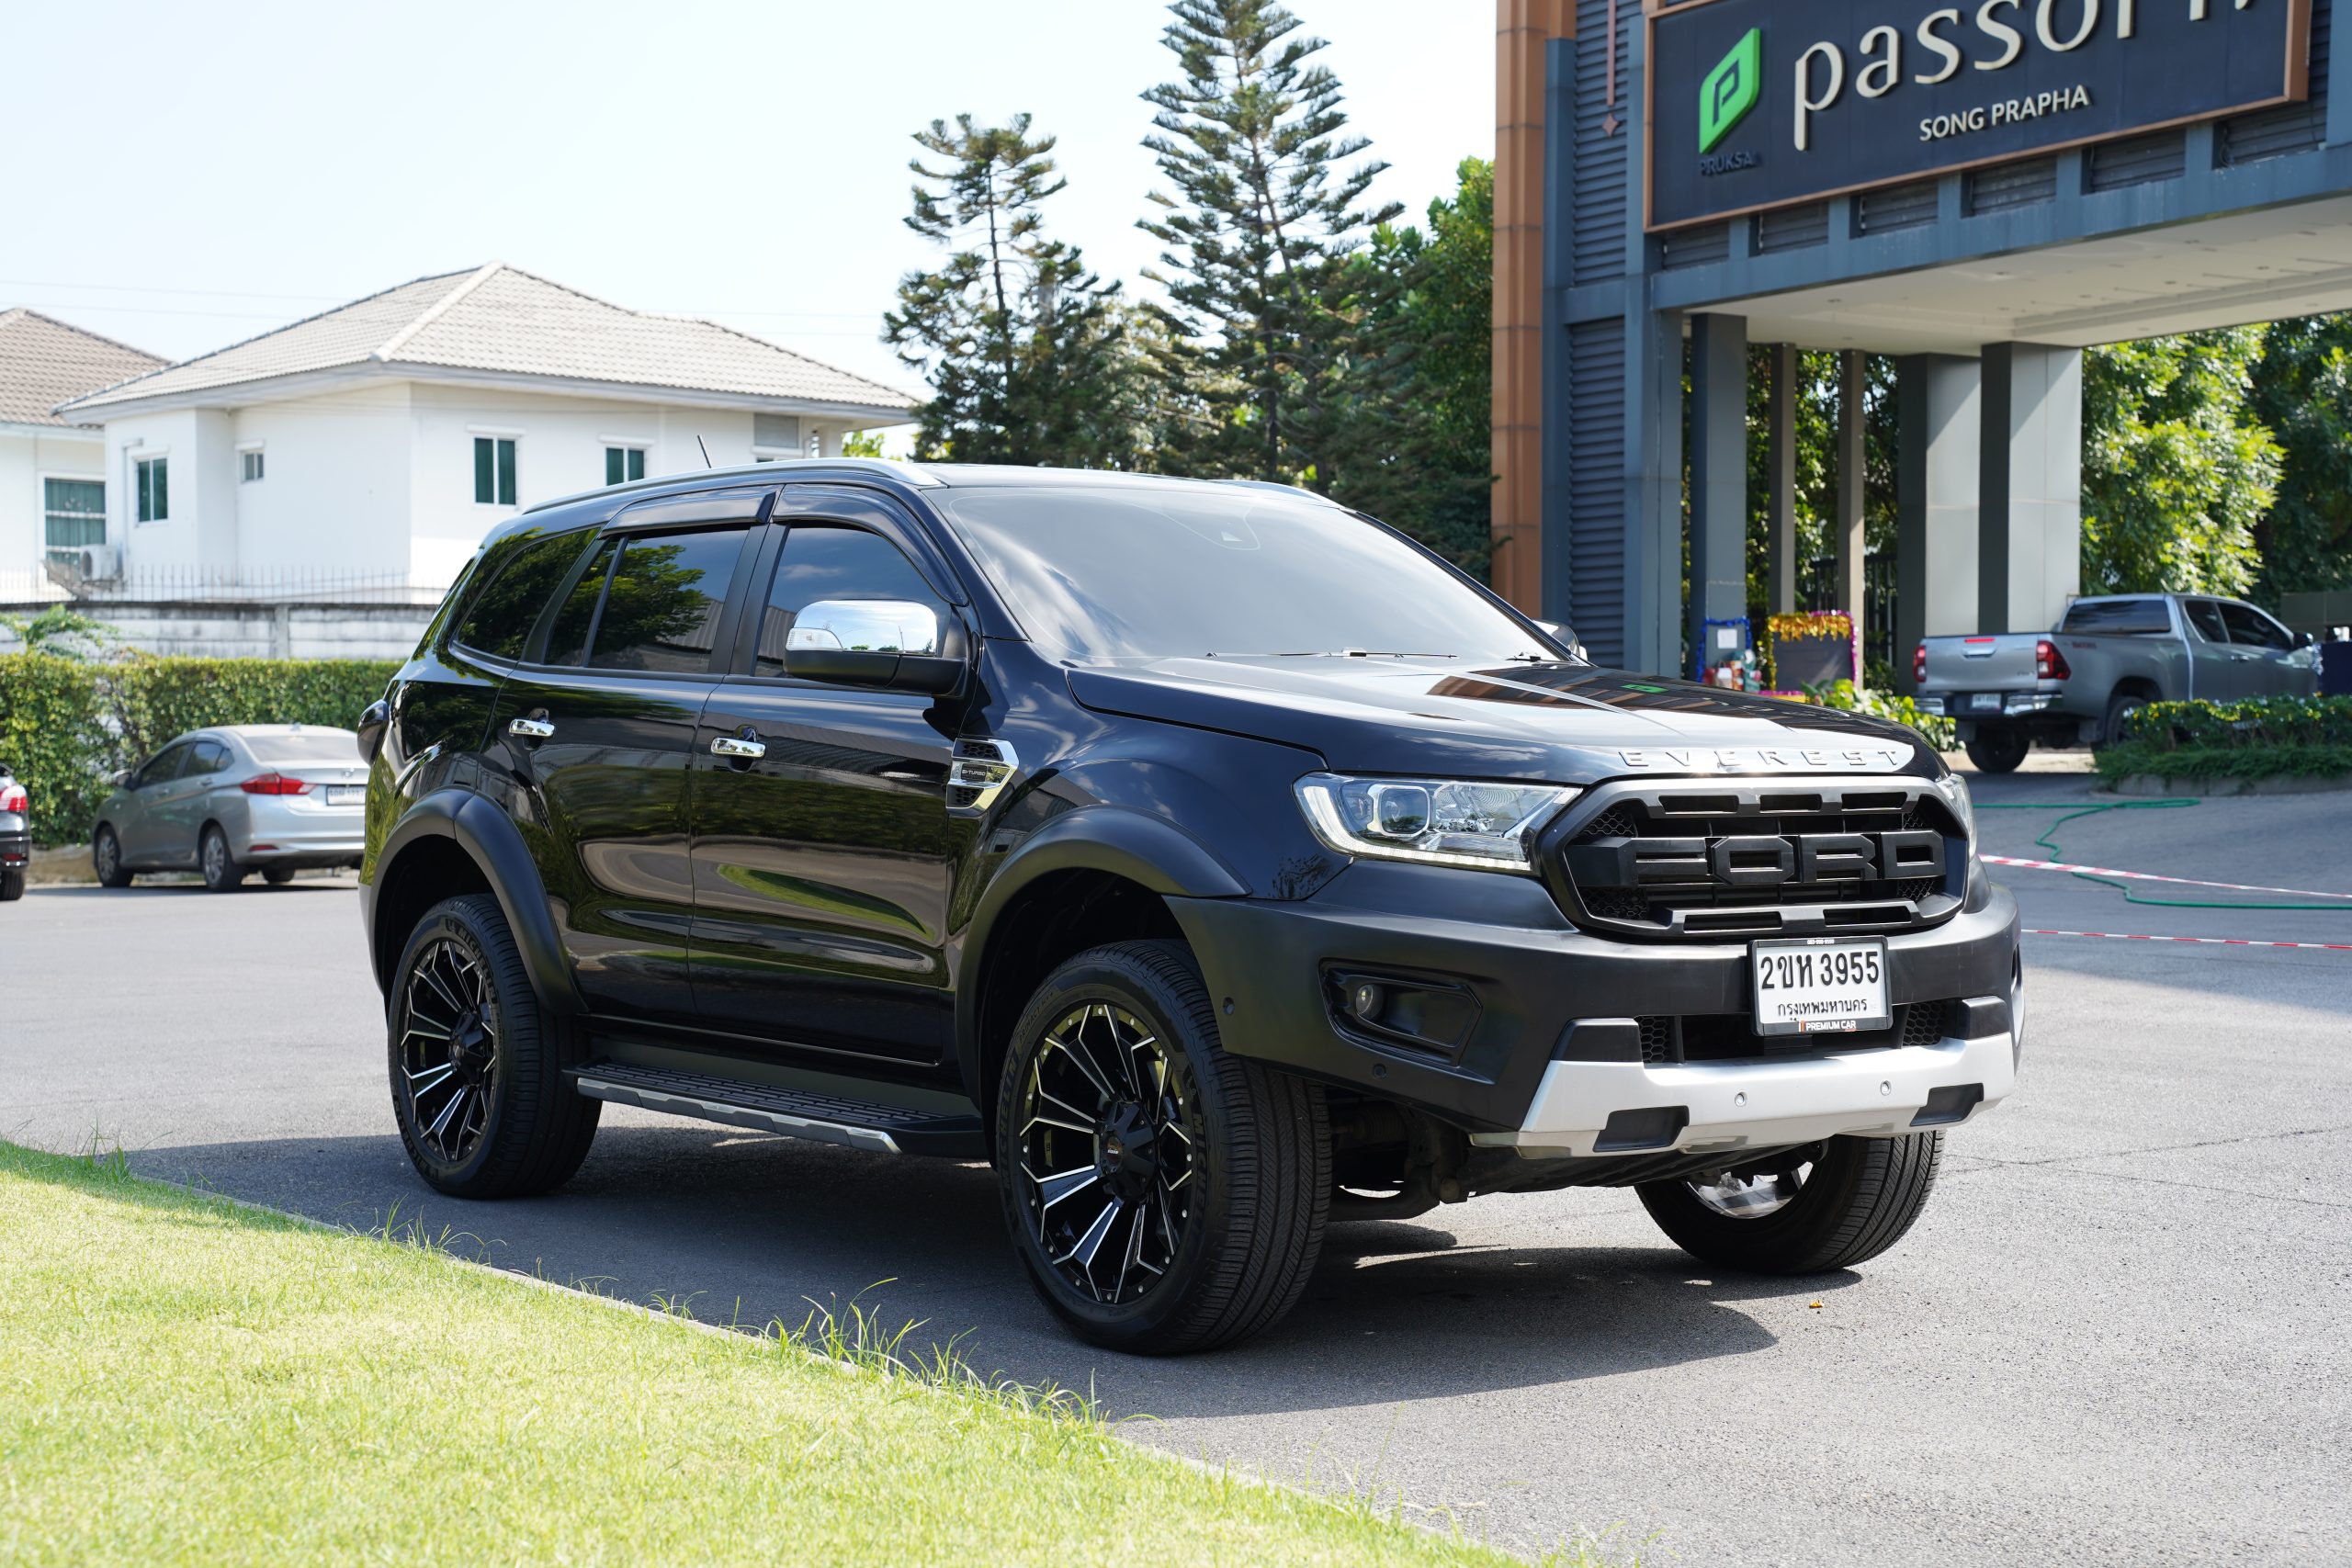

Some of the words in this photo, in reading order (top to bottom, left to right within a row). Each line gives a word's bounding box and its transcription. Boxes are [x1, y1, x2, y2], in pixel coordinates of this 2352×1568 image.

[1919, 107, 1985, 141] SONG
[1991, 85, 2090, 127] PRAPHA
[1699, 151, 1754, 175] PRUKSA
[1618, 750, 1899, 768] EVEREST
[1620, 830, 1946, 887] FORD
[1760, 953, 1814, 989] 2ขห
[1820, 951, 1879, 986] 3955
[1778, 998, 1867, 1017] กรุงเทพมหานคร
[1805, 1021, 1840, 1032] PREMIUM
[1840, 1020, 1856, 1030] CAR
